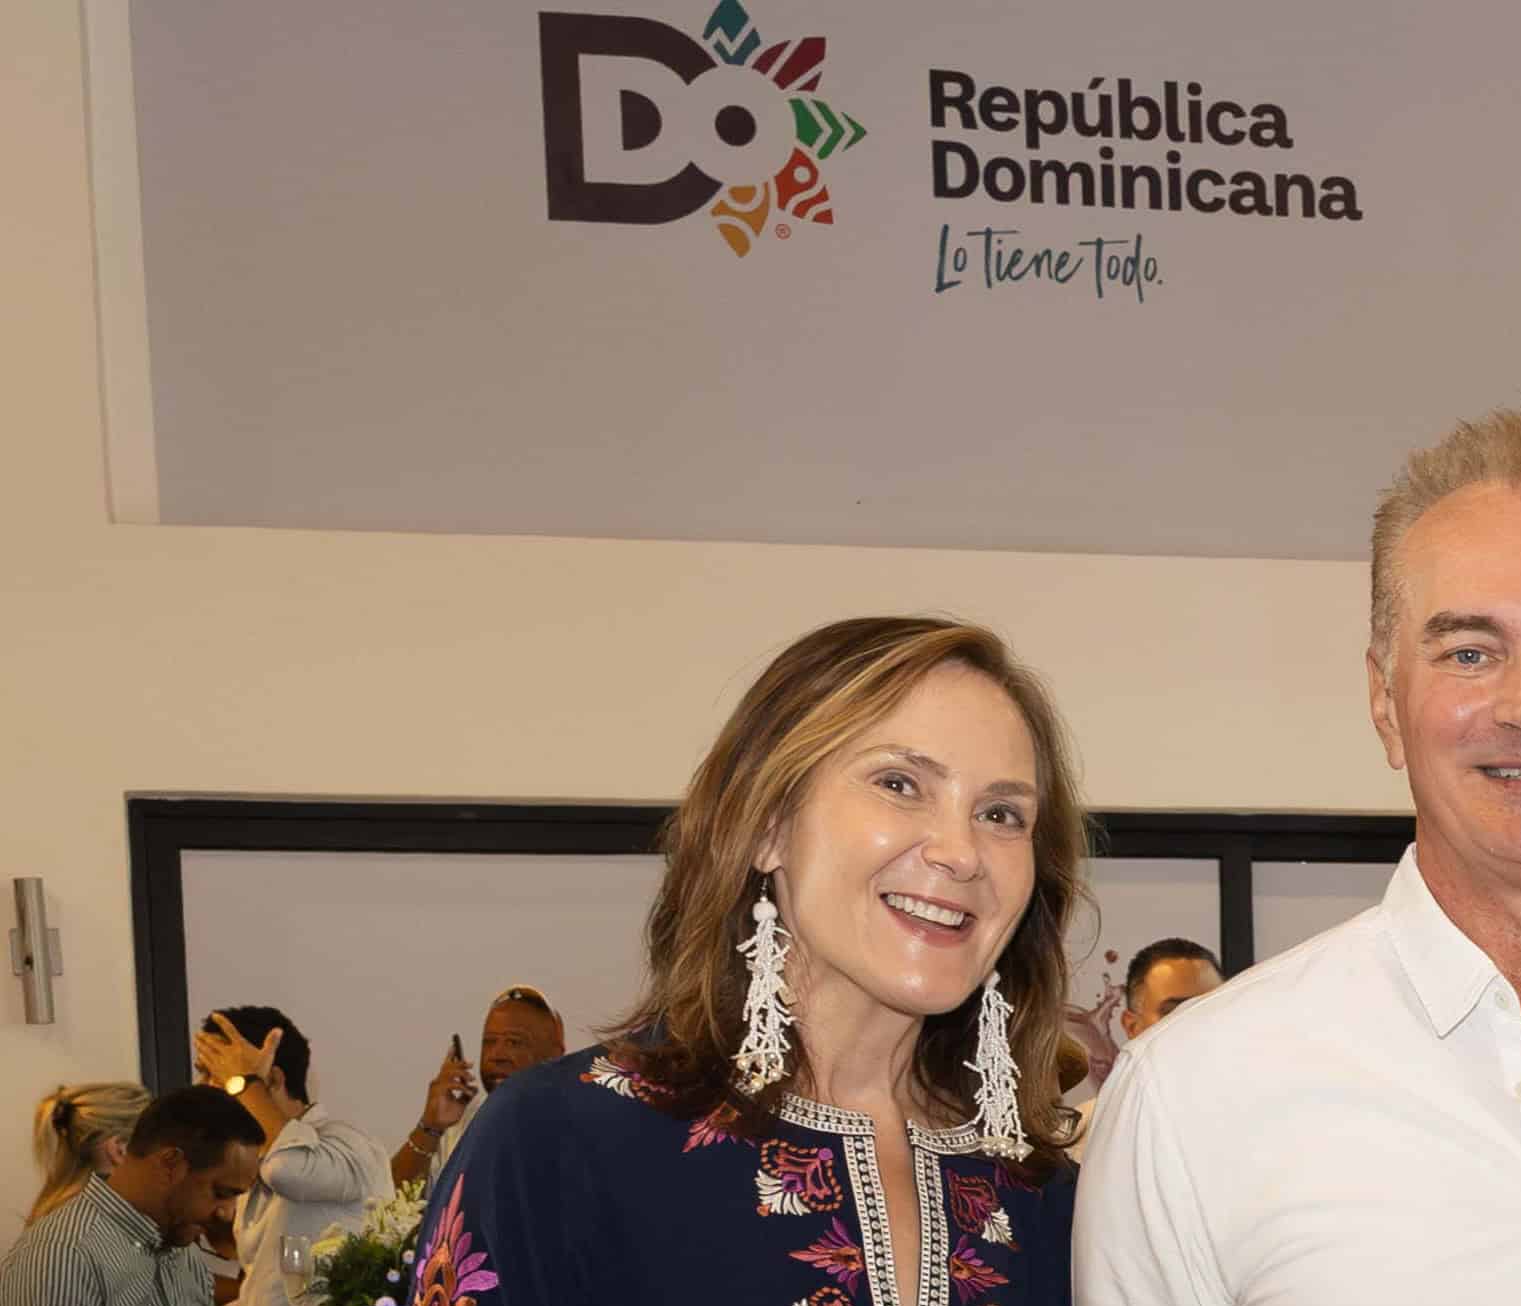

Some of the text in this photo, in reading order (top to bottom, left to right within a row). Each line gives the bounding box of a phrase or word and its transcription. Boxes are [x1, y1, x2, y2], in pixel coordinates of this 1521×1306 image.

[929, 69, 1293, 150] República
[930, 139, 1363, 223] Dominicana
[935, 223, 969, 294] Lo
